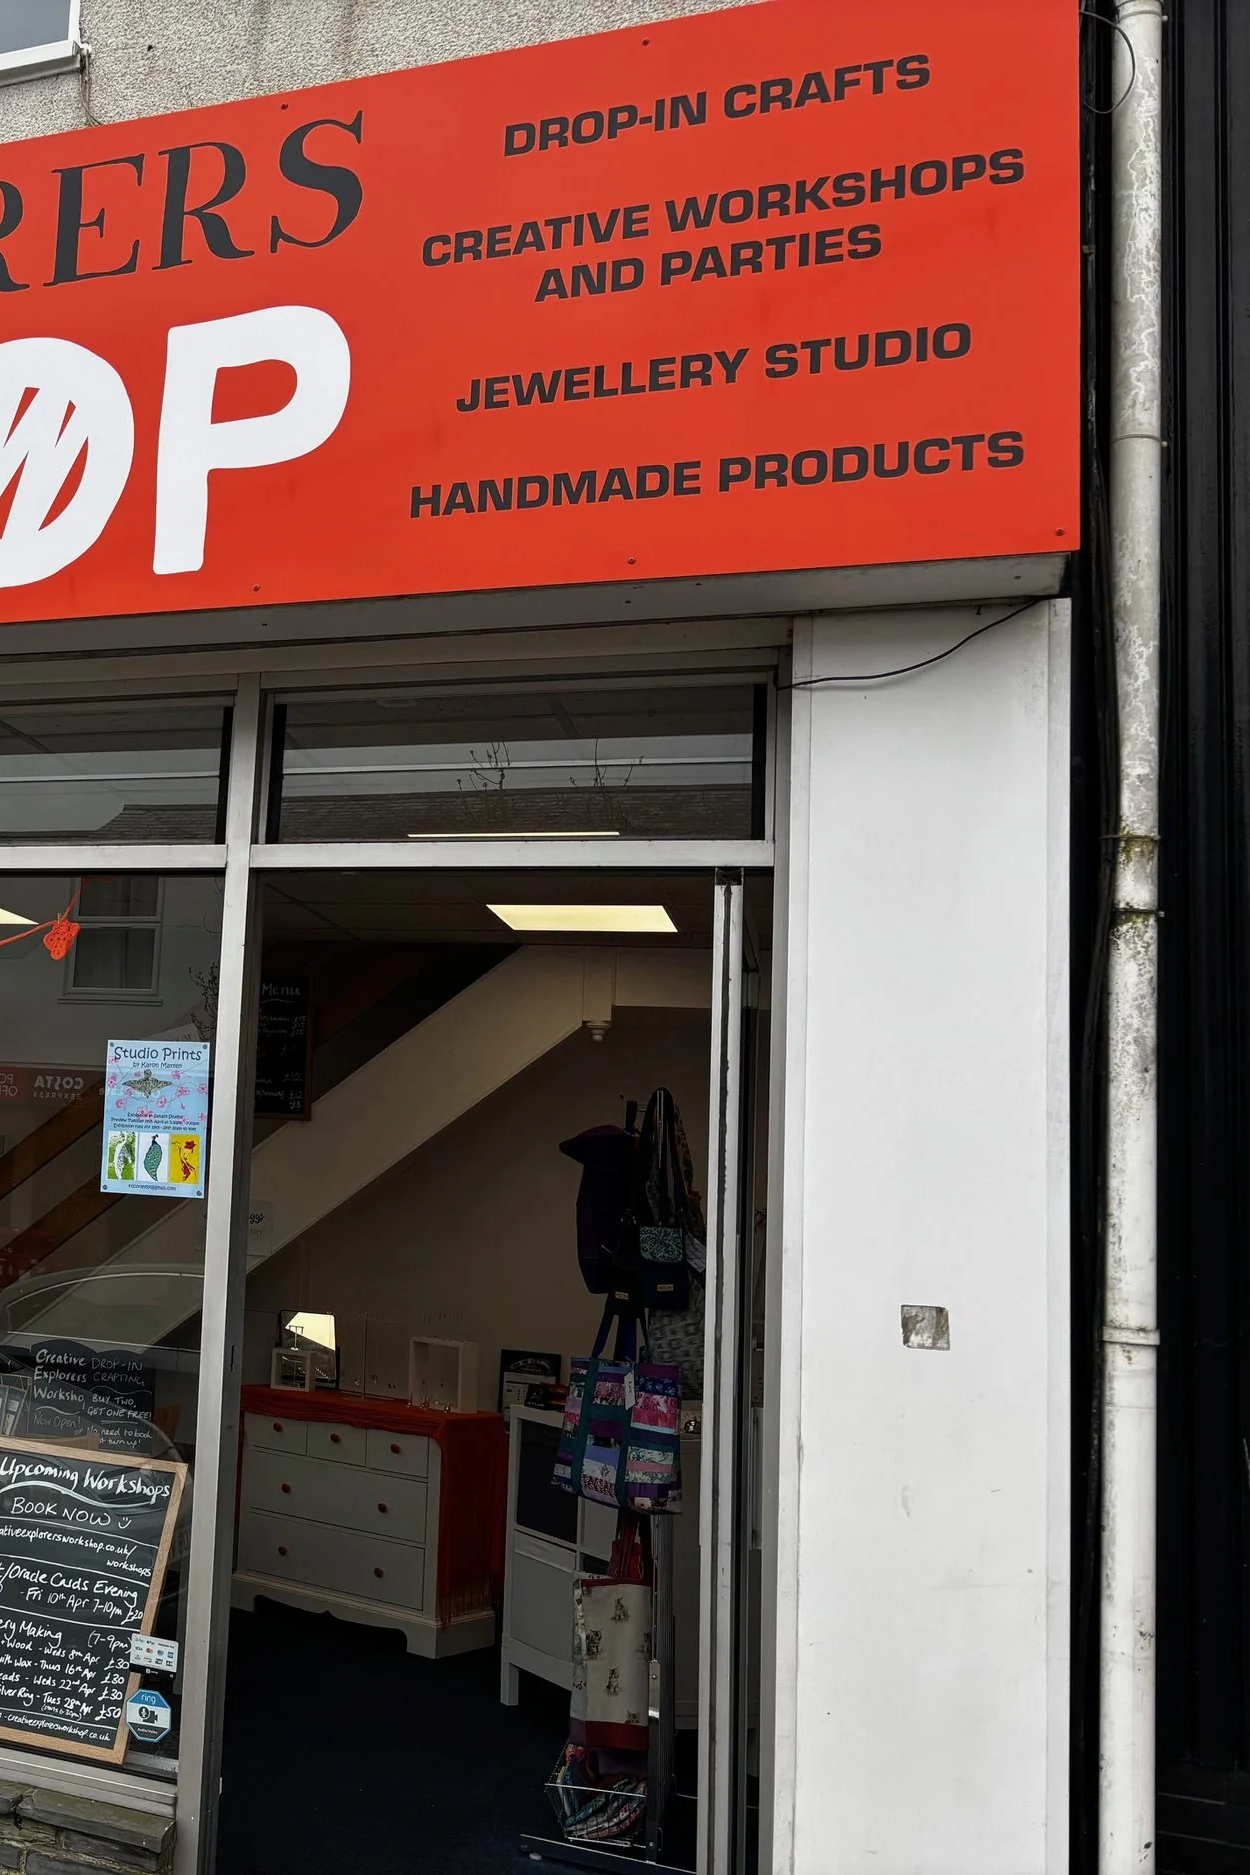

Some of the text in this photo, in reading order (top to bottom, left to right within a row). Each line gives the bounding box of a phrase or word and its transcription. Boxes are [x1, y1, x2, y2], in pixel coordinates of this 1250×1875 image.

[503, 53, 931, 157] DROP-IN CRAFTS
[421, 147, 1026, 267] CREATIVE WORKSHOPS
[534, 223, 883, 303] AND PARTIES
[455, 322, 972, 413] JEWELLERY STUDIO
[410, 430, 1025, 520] HANDMADE PRODUCTS
[261, 982, 301, 997] Menu
[114, 1046, 202, 1061] Studio Prints
[35, 1348, 88, 1366] Creative
[91, 1357, 143, 1371] DROP-IN
[33, 1365, 87, 1383] Explorers
[92, 1371, 145, 1387] CRAFTING
[92, 1393, 111, 1405] BUY
[87, 1407, 152, 1421] GET ONE FREE!
[101, 1427, 153, 1439] need to book
[0, 1456, 171, 1505] Upcoming Workshops
[10, 1496, 111, 1527] BOOK NOW
[106, 1558, 152, 1577] workshops
[50, 1572, 90, 1591] Cards
[93, 1580, 138, 1608] Evening
[66, 1594, 90, 1612] Apr
[20, 1620, 63, 1648] Making
[6, 1638, 33, 1651] Wood
[83, 1653, 101, 1669] Apr
[103, 1659, 130, 1672] £30
[81, 1668, 98, 1684] Apr
[100, 1675, 125, 1685] £30
[33, 1675, 56, 1687] Weds
[79, 1684, 96, 1700] Apr
[97, 1690, 123, 1701] £30
[17, 1687, 35, 1707] Ring
[79, 1702, 94, 1716] Apr
[94, 1706, 122, 1721] £50
[141, 1693, 157, 1706] ring
